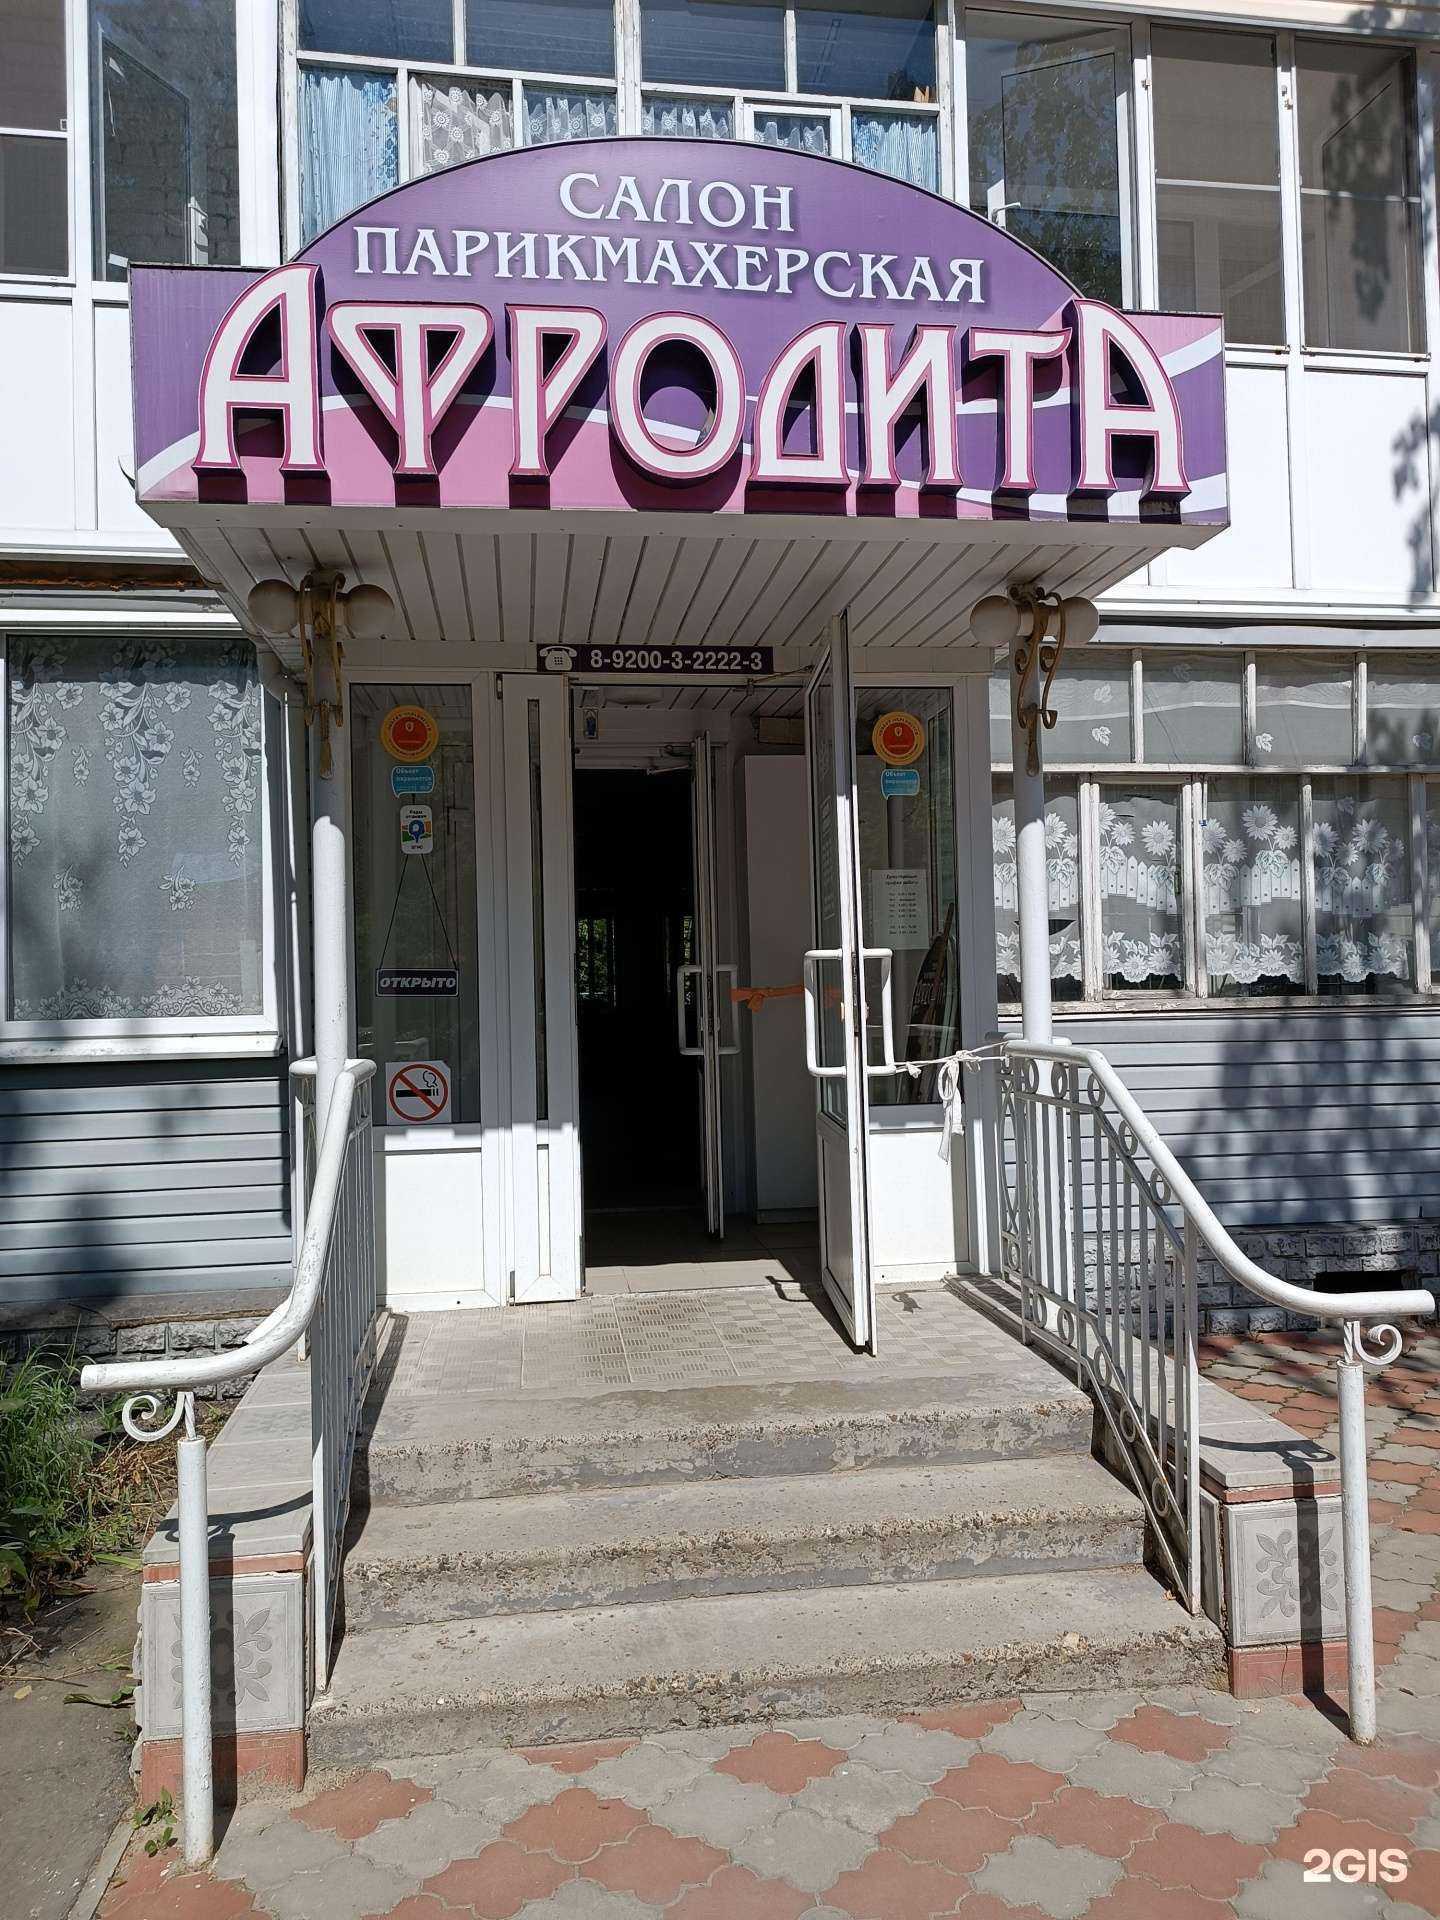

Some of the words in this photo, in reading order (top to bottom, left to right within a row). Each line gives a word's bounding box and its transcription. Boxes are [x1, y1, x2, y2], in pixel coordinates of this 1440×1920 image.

[558, 172, 794, 232] САЛОН
[353, 226, 986, 303] ПАРИКМАХЕРСКАЯ
[192, 262, 1191, 495] АФРОДИТА
[590, 649, 763, 671] 8-9200-3-2222-3
[380, 977, 456, 988] ОТКРЫТО
